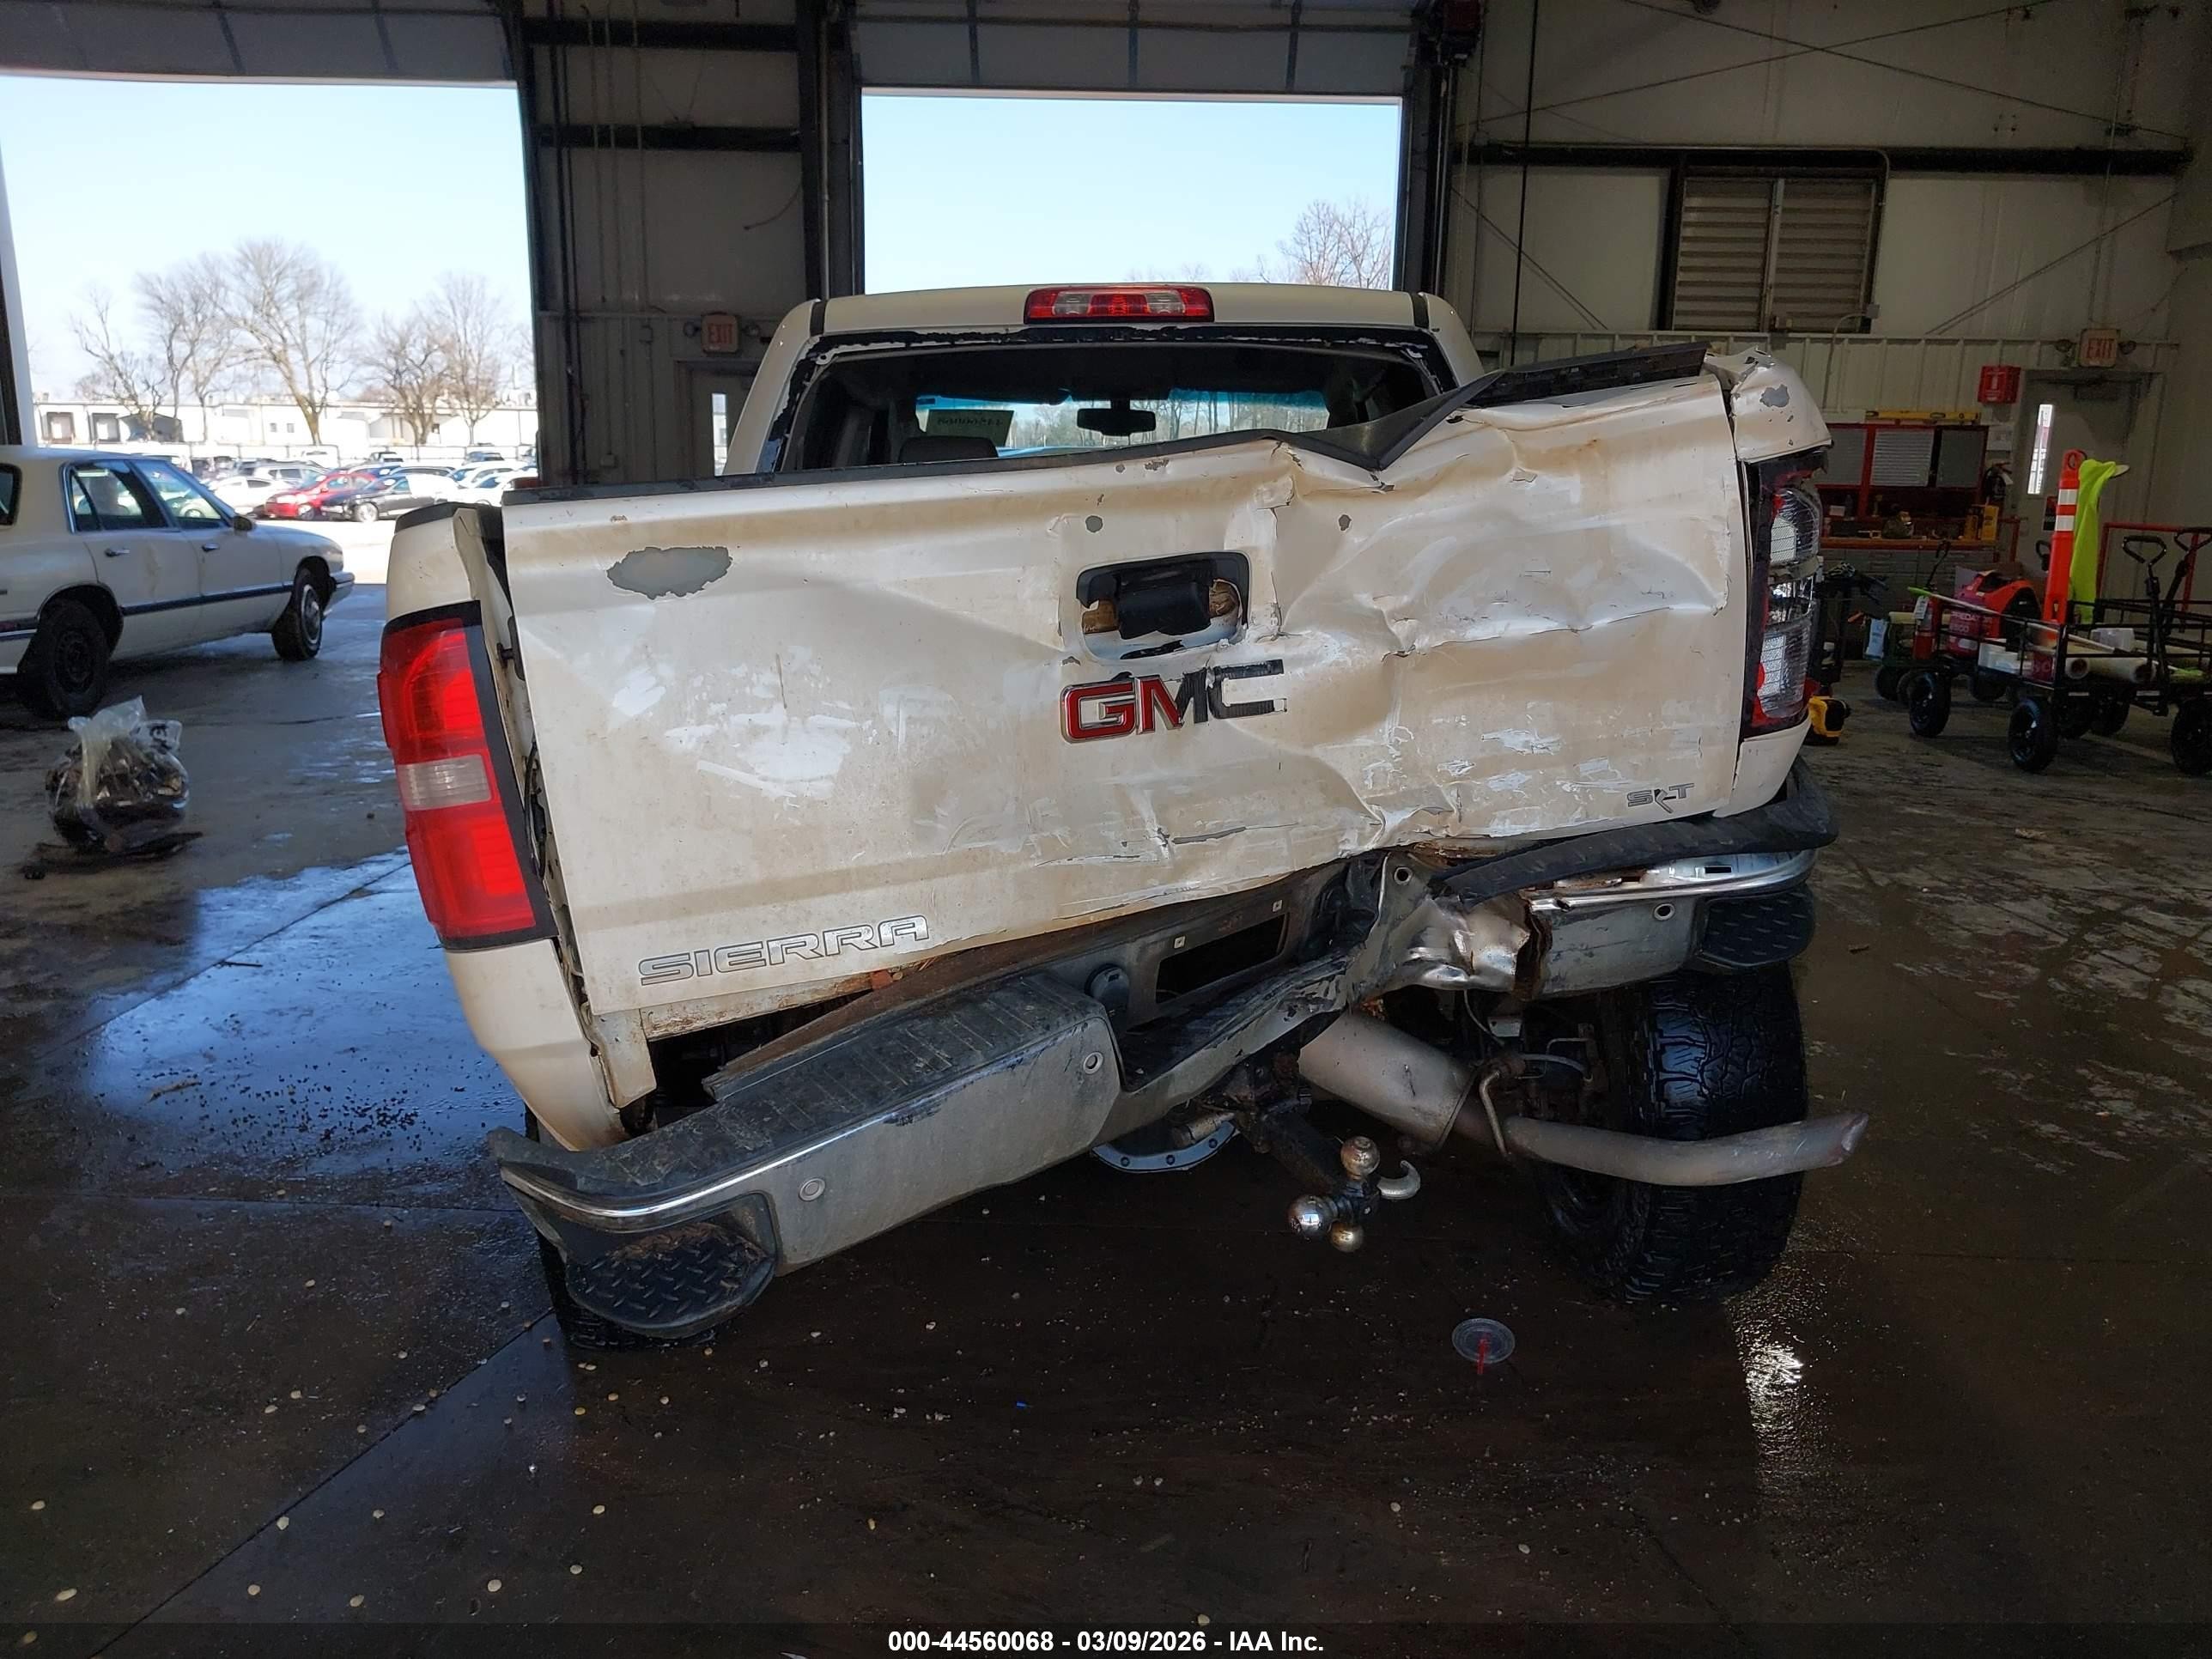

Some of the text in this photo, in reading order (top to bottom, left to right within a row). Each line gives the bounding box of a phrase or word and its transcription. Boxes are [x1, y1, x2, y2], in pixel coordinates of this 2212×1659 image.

[2087, 337, 2115, 359] EXIT
[1060, 659, 1288, 744] GMC
[638, 914, 931, 987] SIERRA
